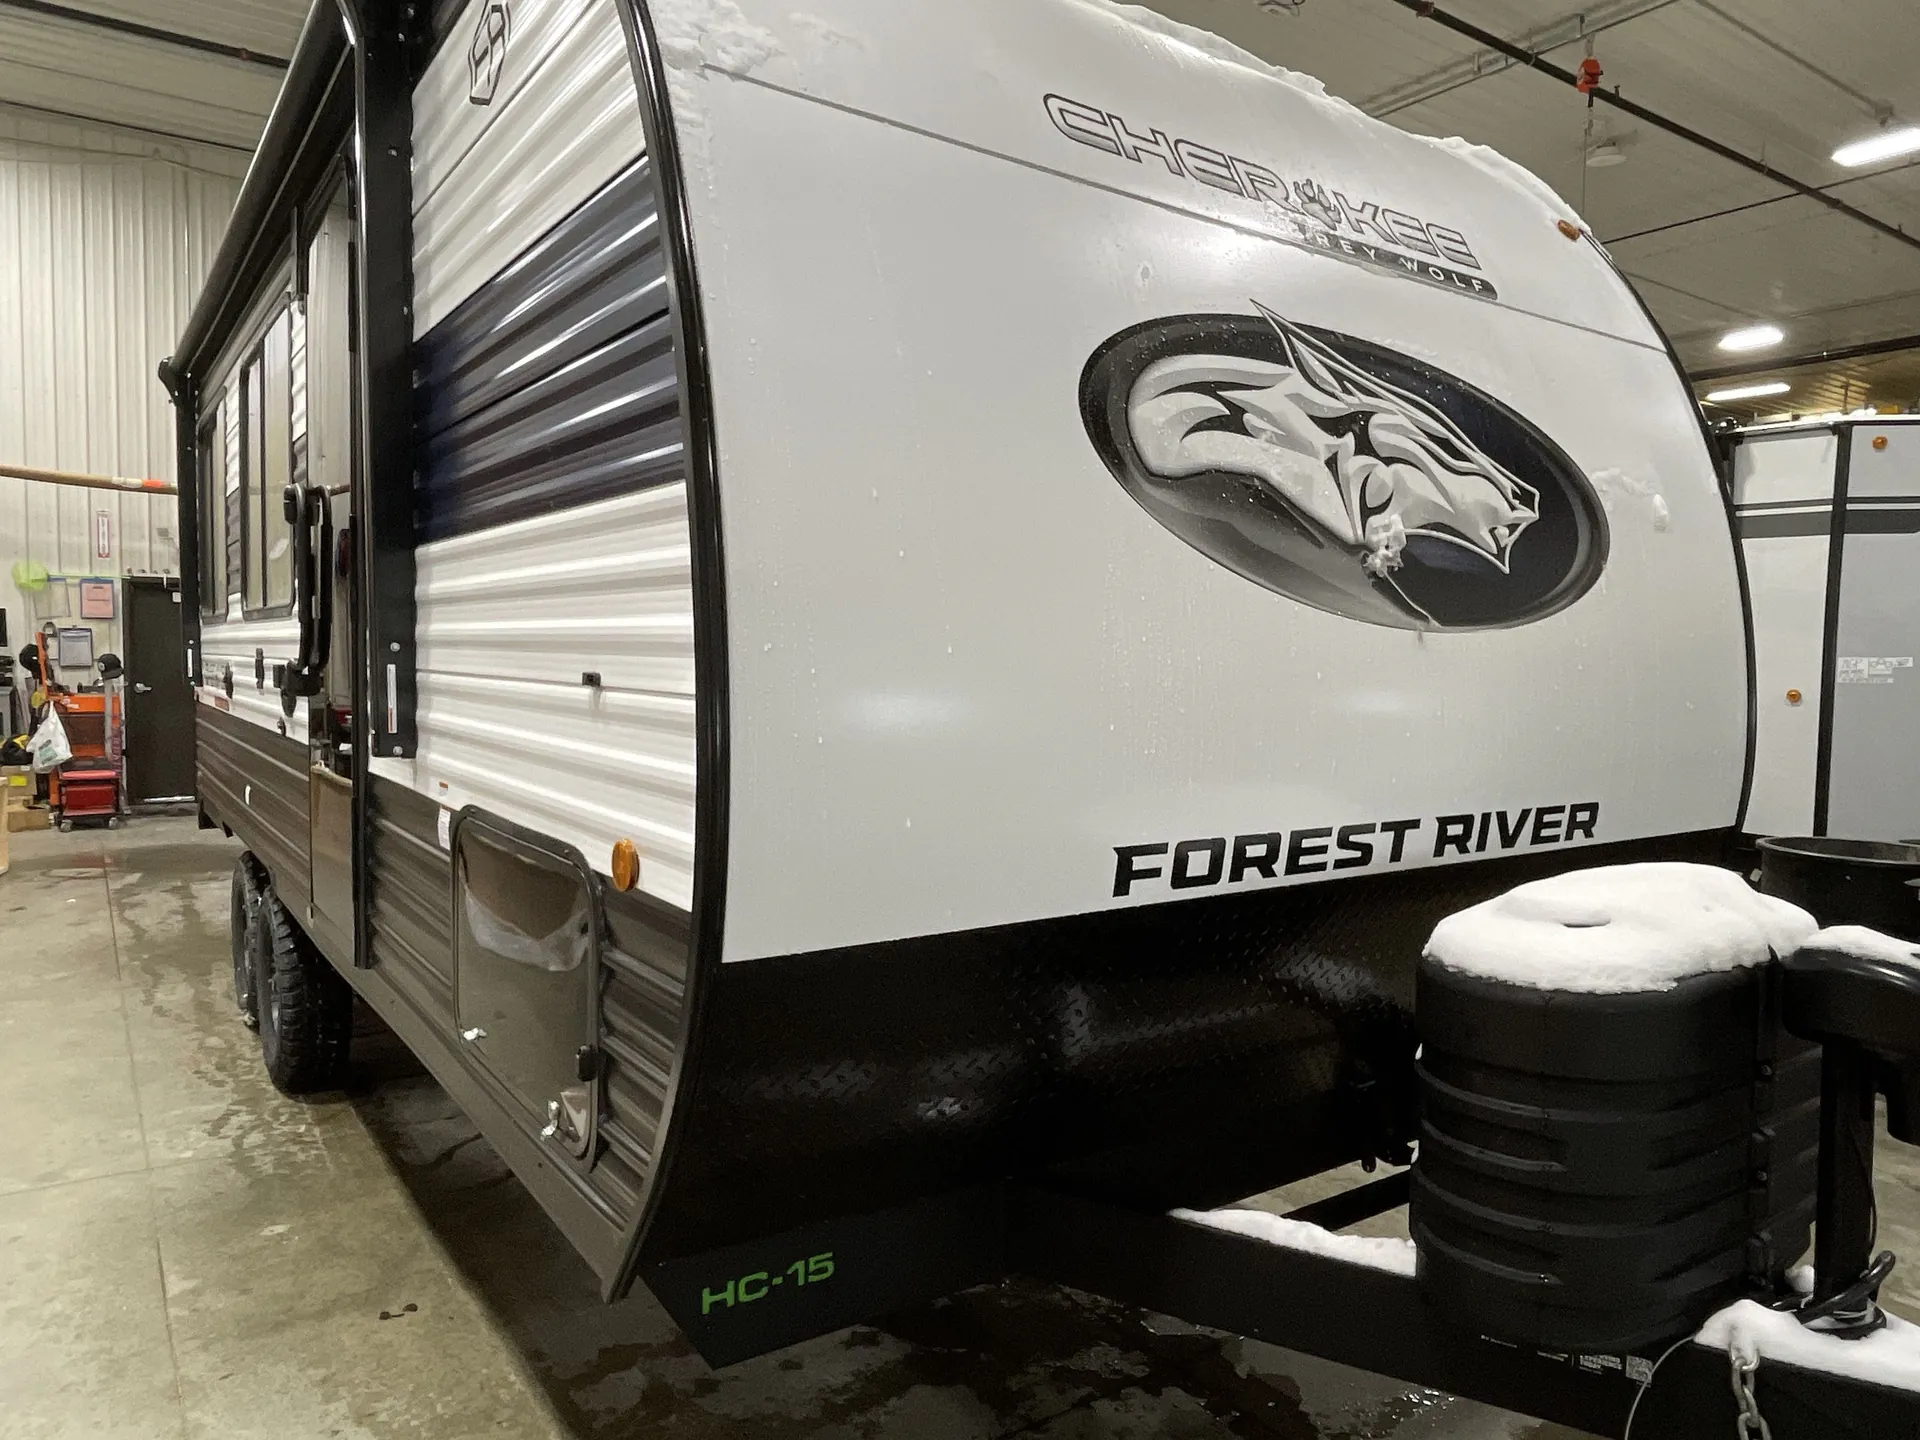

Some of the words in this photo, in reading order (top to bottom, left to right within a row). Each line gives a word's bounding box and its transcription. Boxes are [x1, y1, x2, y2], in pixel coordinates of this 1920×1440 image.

[1301, 230, 1377, 261] REY
[1400, 258, 1484, 293] WOLF
[1112, 819, 1421, 898] FOREST
[1433, 802, 1599, 858] RIVER
[702, 1251, 835, 1315] HC-15
